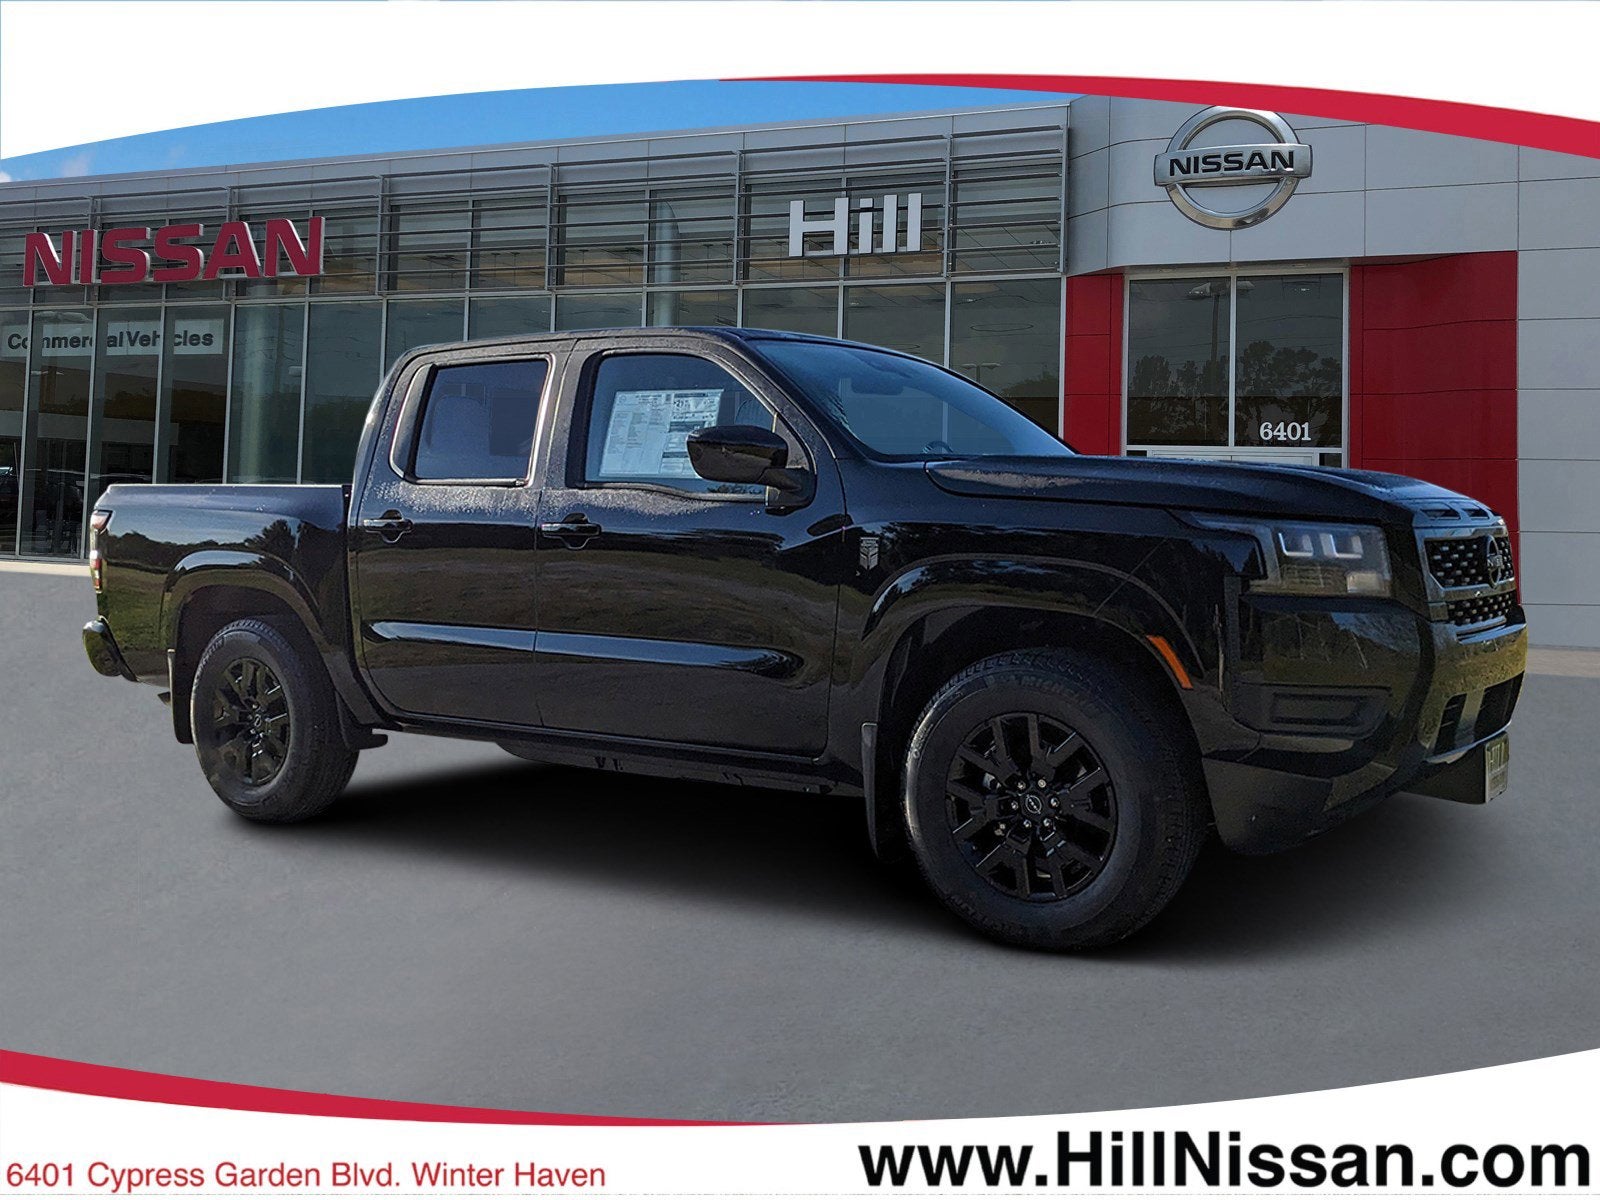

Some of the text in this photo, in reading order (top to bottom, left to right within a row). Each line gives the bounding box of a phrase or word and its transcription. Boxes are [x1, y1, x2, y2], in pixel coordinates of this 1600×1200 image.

[1169, 150, 1294, 177] NISSAN
[788, 192, 922, 257] Hill
[23, 216, 326, 287] NISSAN
[7, 330, 214, 350] Commeral Vehcles
[1259, 421, 1312, 441] 6401
